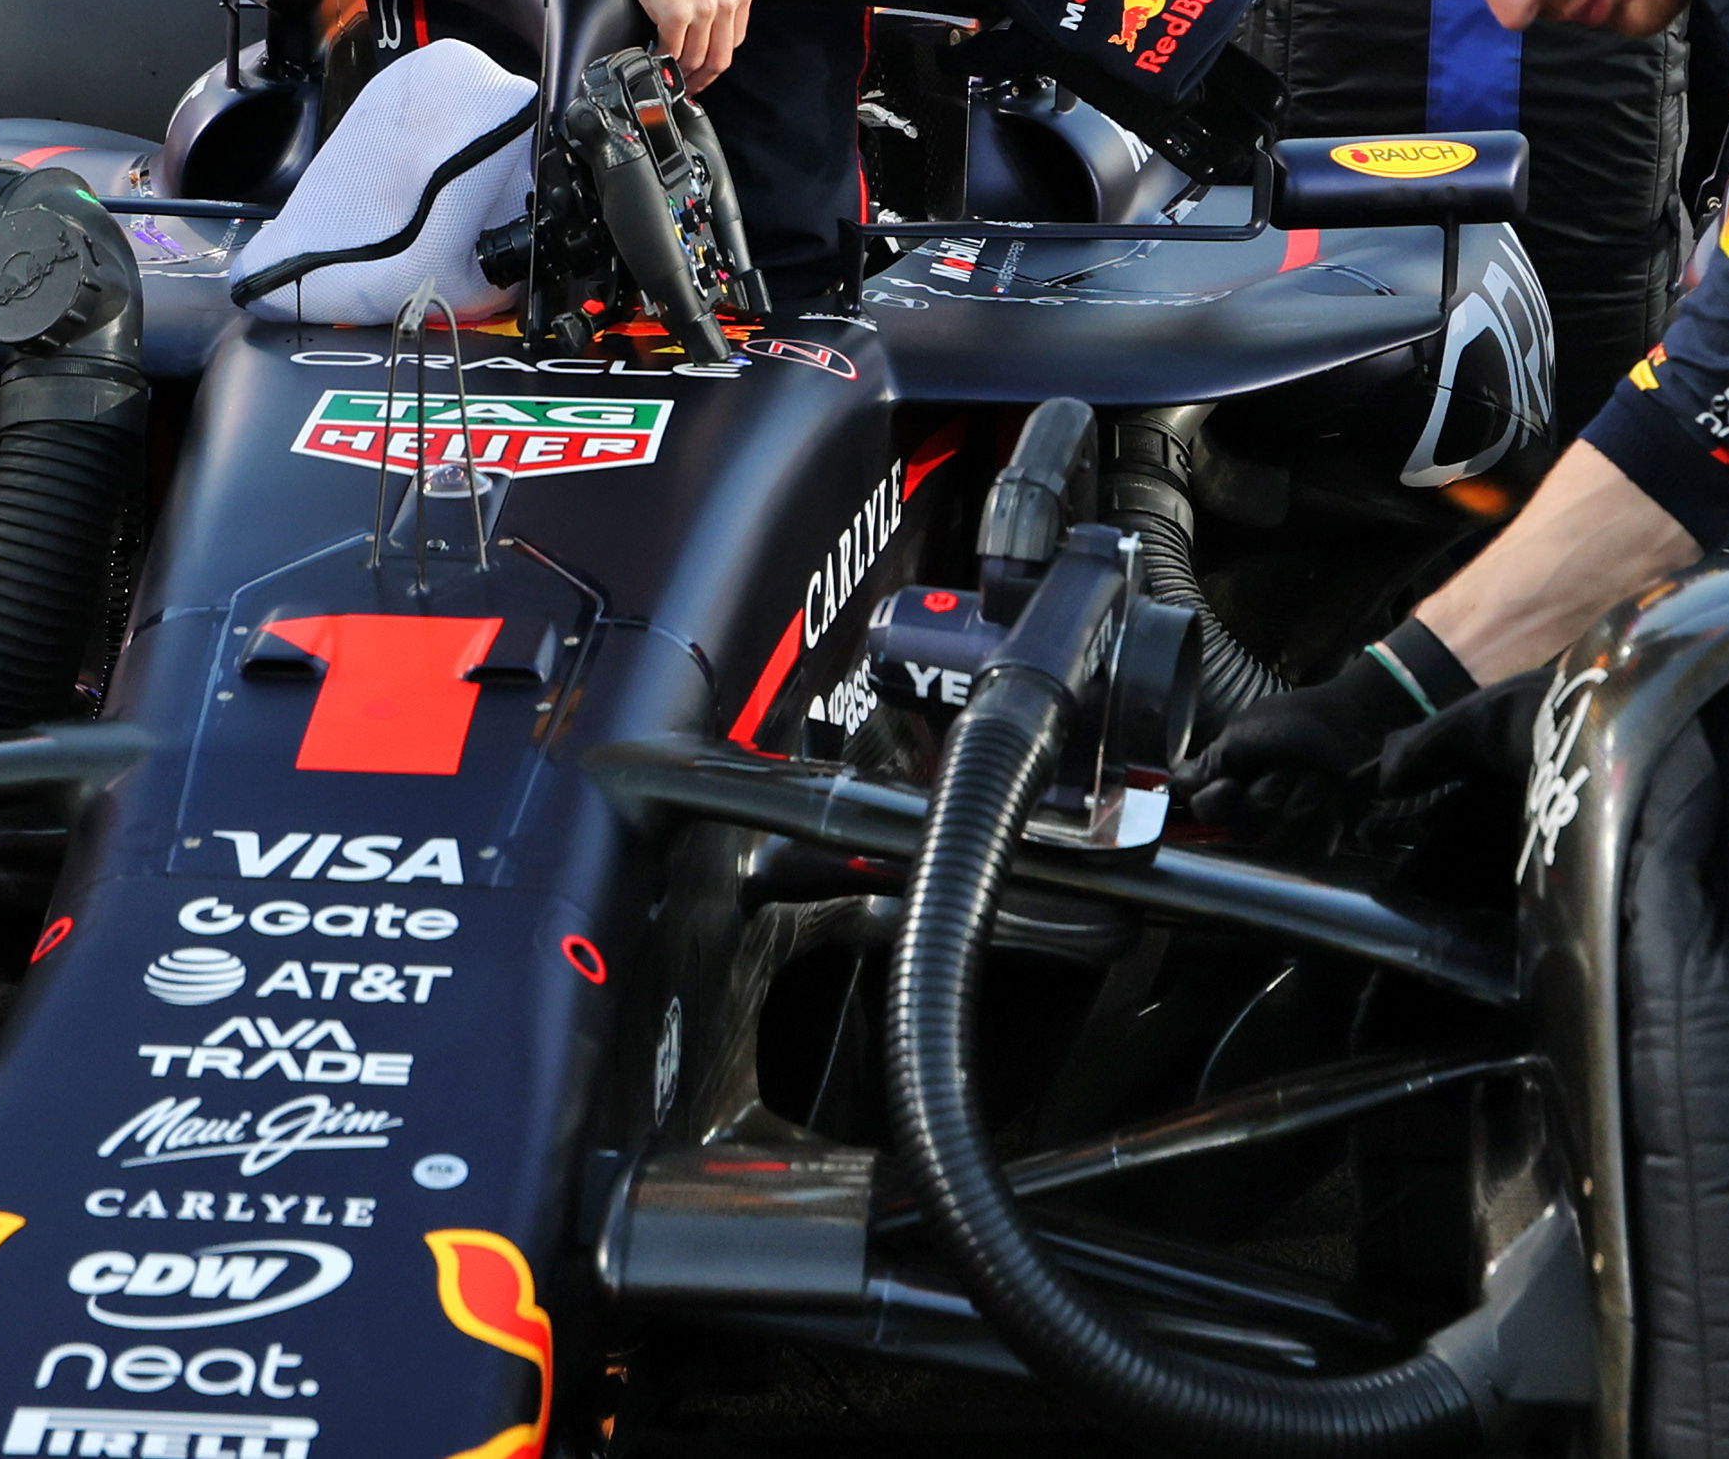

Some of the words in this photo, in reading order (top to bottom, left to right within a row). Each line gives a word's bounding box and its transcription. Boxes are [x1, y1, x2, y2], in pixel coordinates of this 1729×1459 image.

[1368, 142, 1460, 163] RAUCH
[290, 349, 754, 380] ORACLE
[350, 397, 639, 427] TAG
[316, 428, 640, 466] HEUER
[804, 457, 903, 649] CARLYLE
[263, 615, 504, 775] 1
[904, 660, 973, 707] YE
[212, 829, 466, 885] VISA
[248, 900, 460, 942] Gate
[256, 960, 453, 1004] AT&T
[203, 1016, 358, 1051] AVA
[138, 1044, 414, 1086] TRADE
[98, 1096, 248, 1158] Maui
[239, 1094, 404, 1177] Jim
[84, 1188, 377, 1227] CARLYLE
[68, 1250, 290, 1301] CDW
